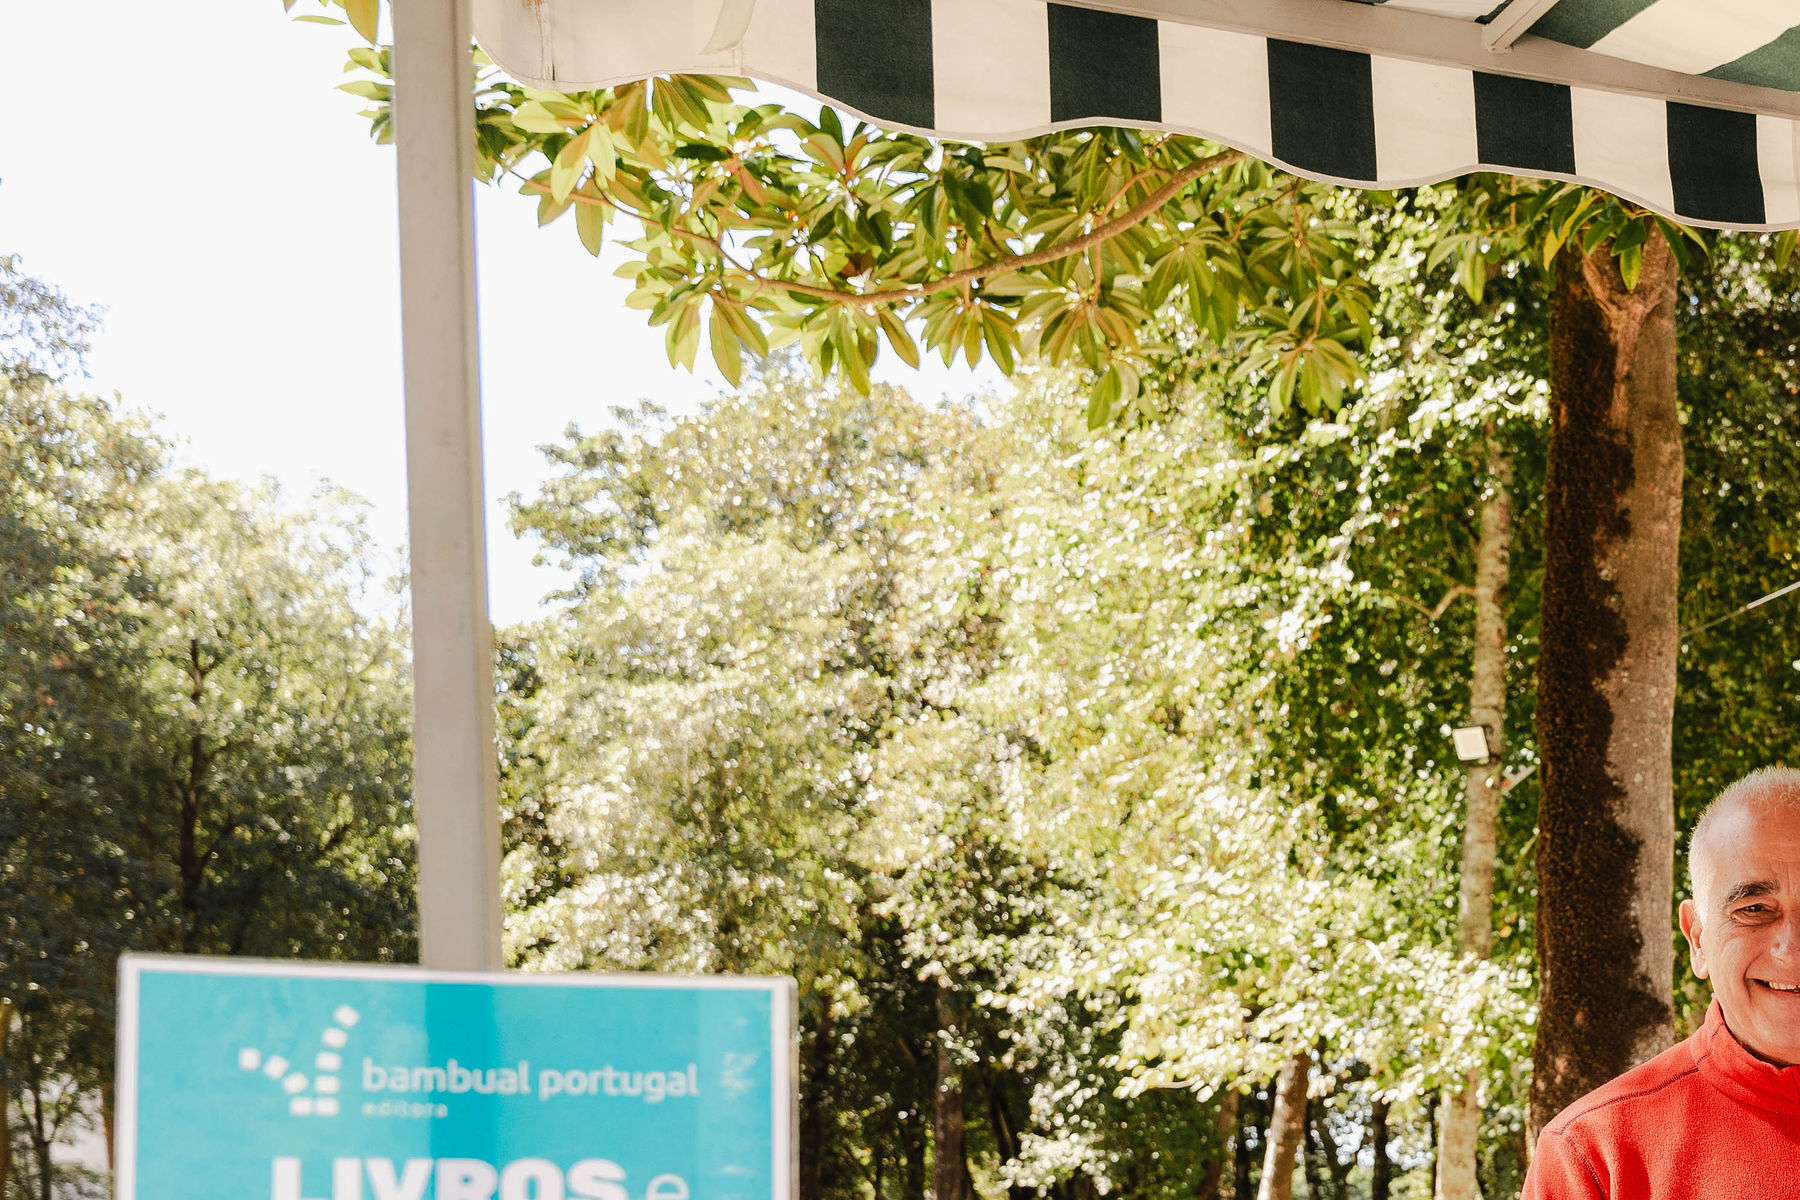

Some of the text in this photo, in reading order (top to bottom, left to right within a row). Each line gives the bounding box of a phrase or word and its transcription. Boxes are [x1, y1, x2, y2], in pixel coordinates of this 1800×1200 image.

[363, 1058, 699, 1103] bambual portugal
[363, 1101, 447, 1118] editora
